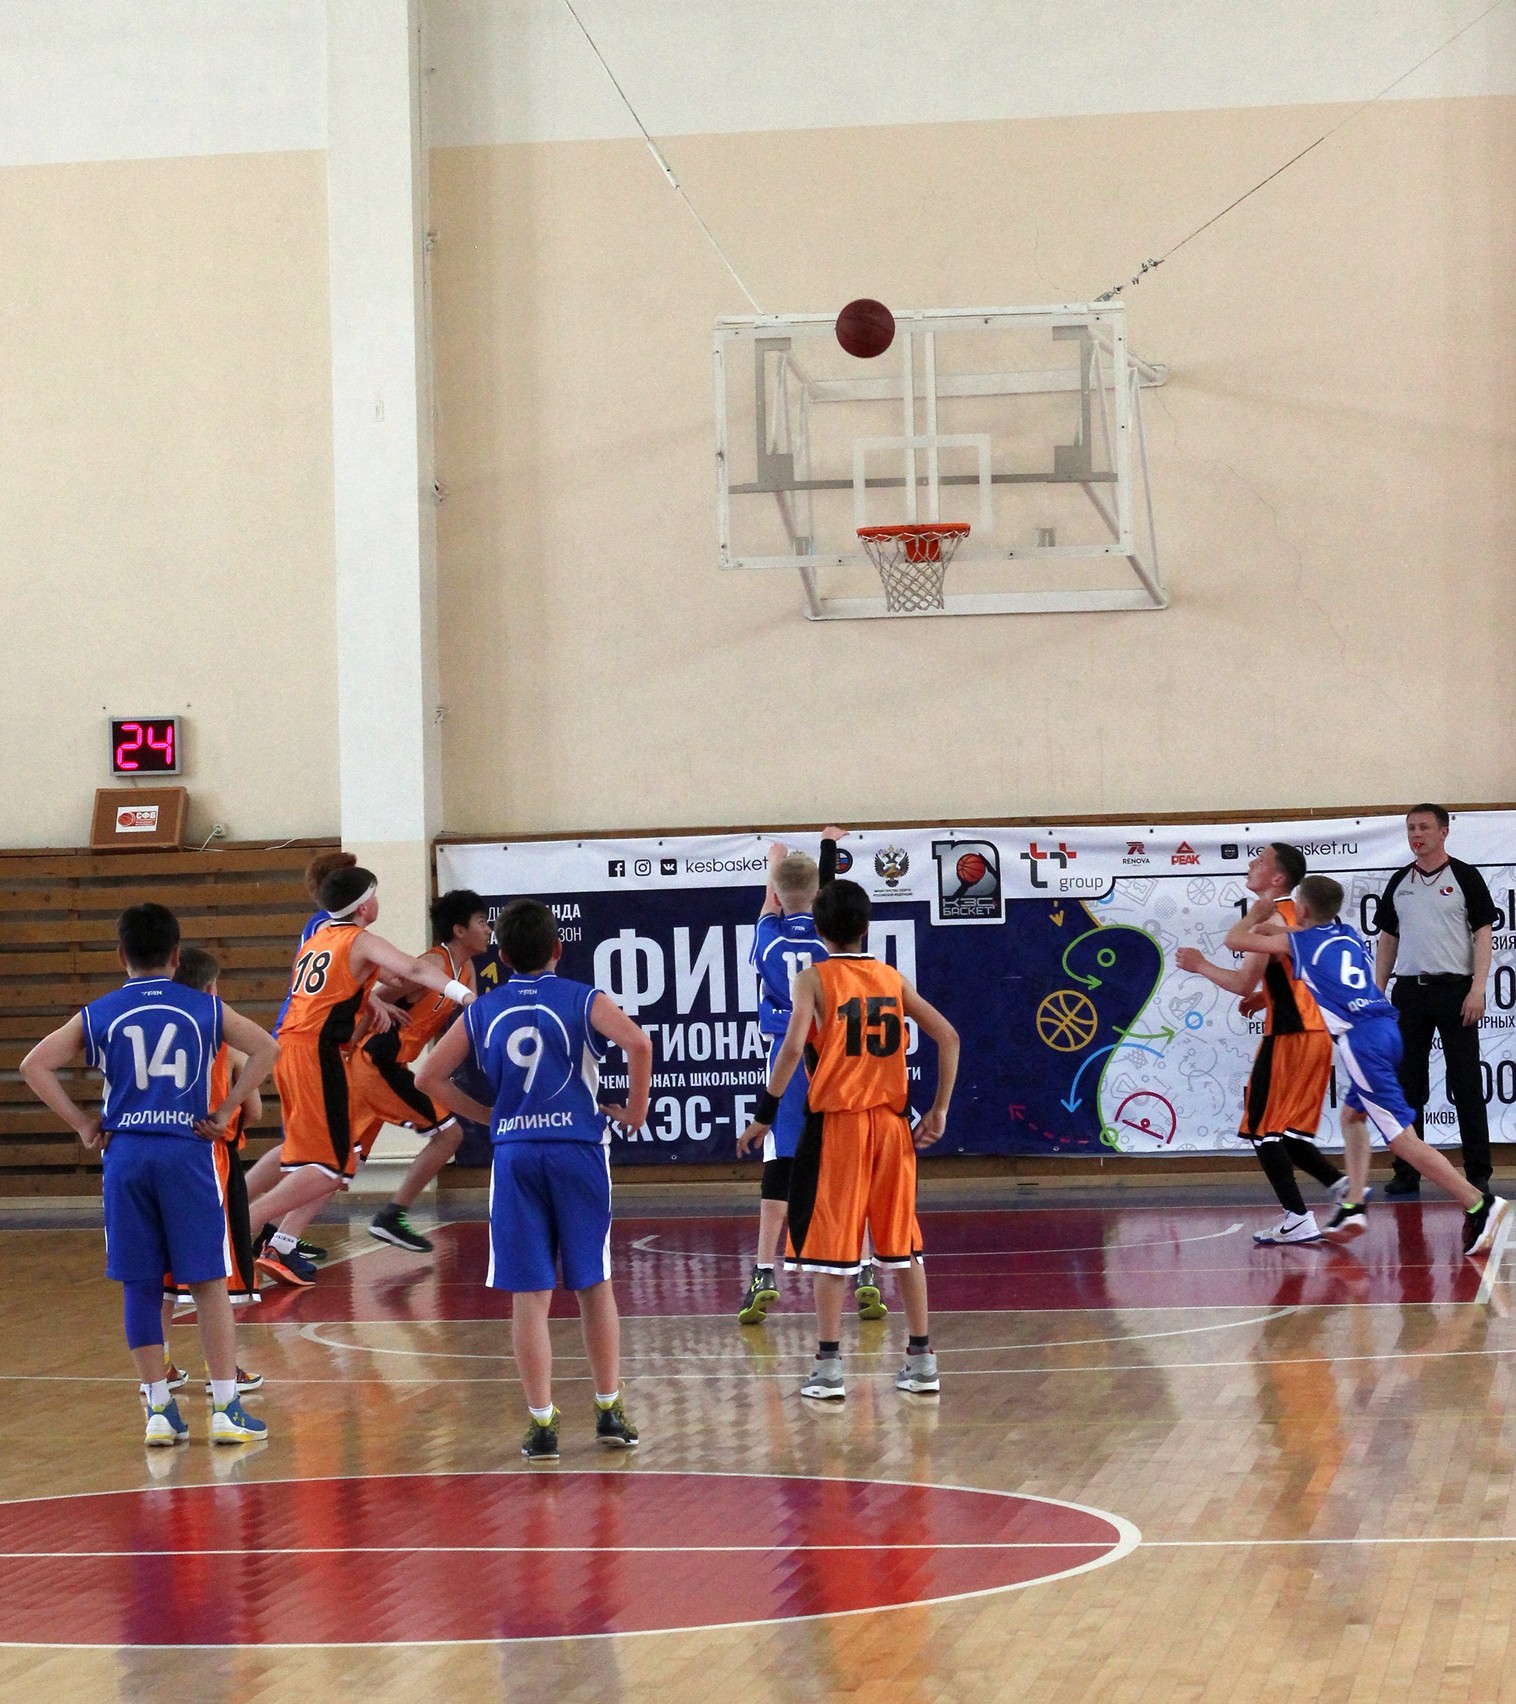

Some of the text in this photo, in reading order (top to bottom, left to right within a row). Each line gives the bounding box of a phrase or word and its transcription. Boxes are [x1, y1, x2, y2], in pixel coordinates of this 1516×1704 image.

[116, 722, 173, 770] 24
[1122, 857, 1150, 865] RENOVA
[1171, 854, 1200, 865] PEAK
[1059, 876, 1103, 891] group
[943, 906, 990, 916] БАСКЕТ
[292, 950, 332, 995] 18
[1340, 949, 1367, 989] 6
[837, 997, 901, 1058] 15
[123, 1022, 188, 1091] 14
[506, 1026, 544, 1094] 9
[690, 1068, 766, 1087] ШКОЛЬНОЙ
[118, 1110, 195, 1128] ДОЛИНСК
[497, 1111, 573, 1135] ДОЛИНСК
